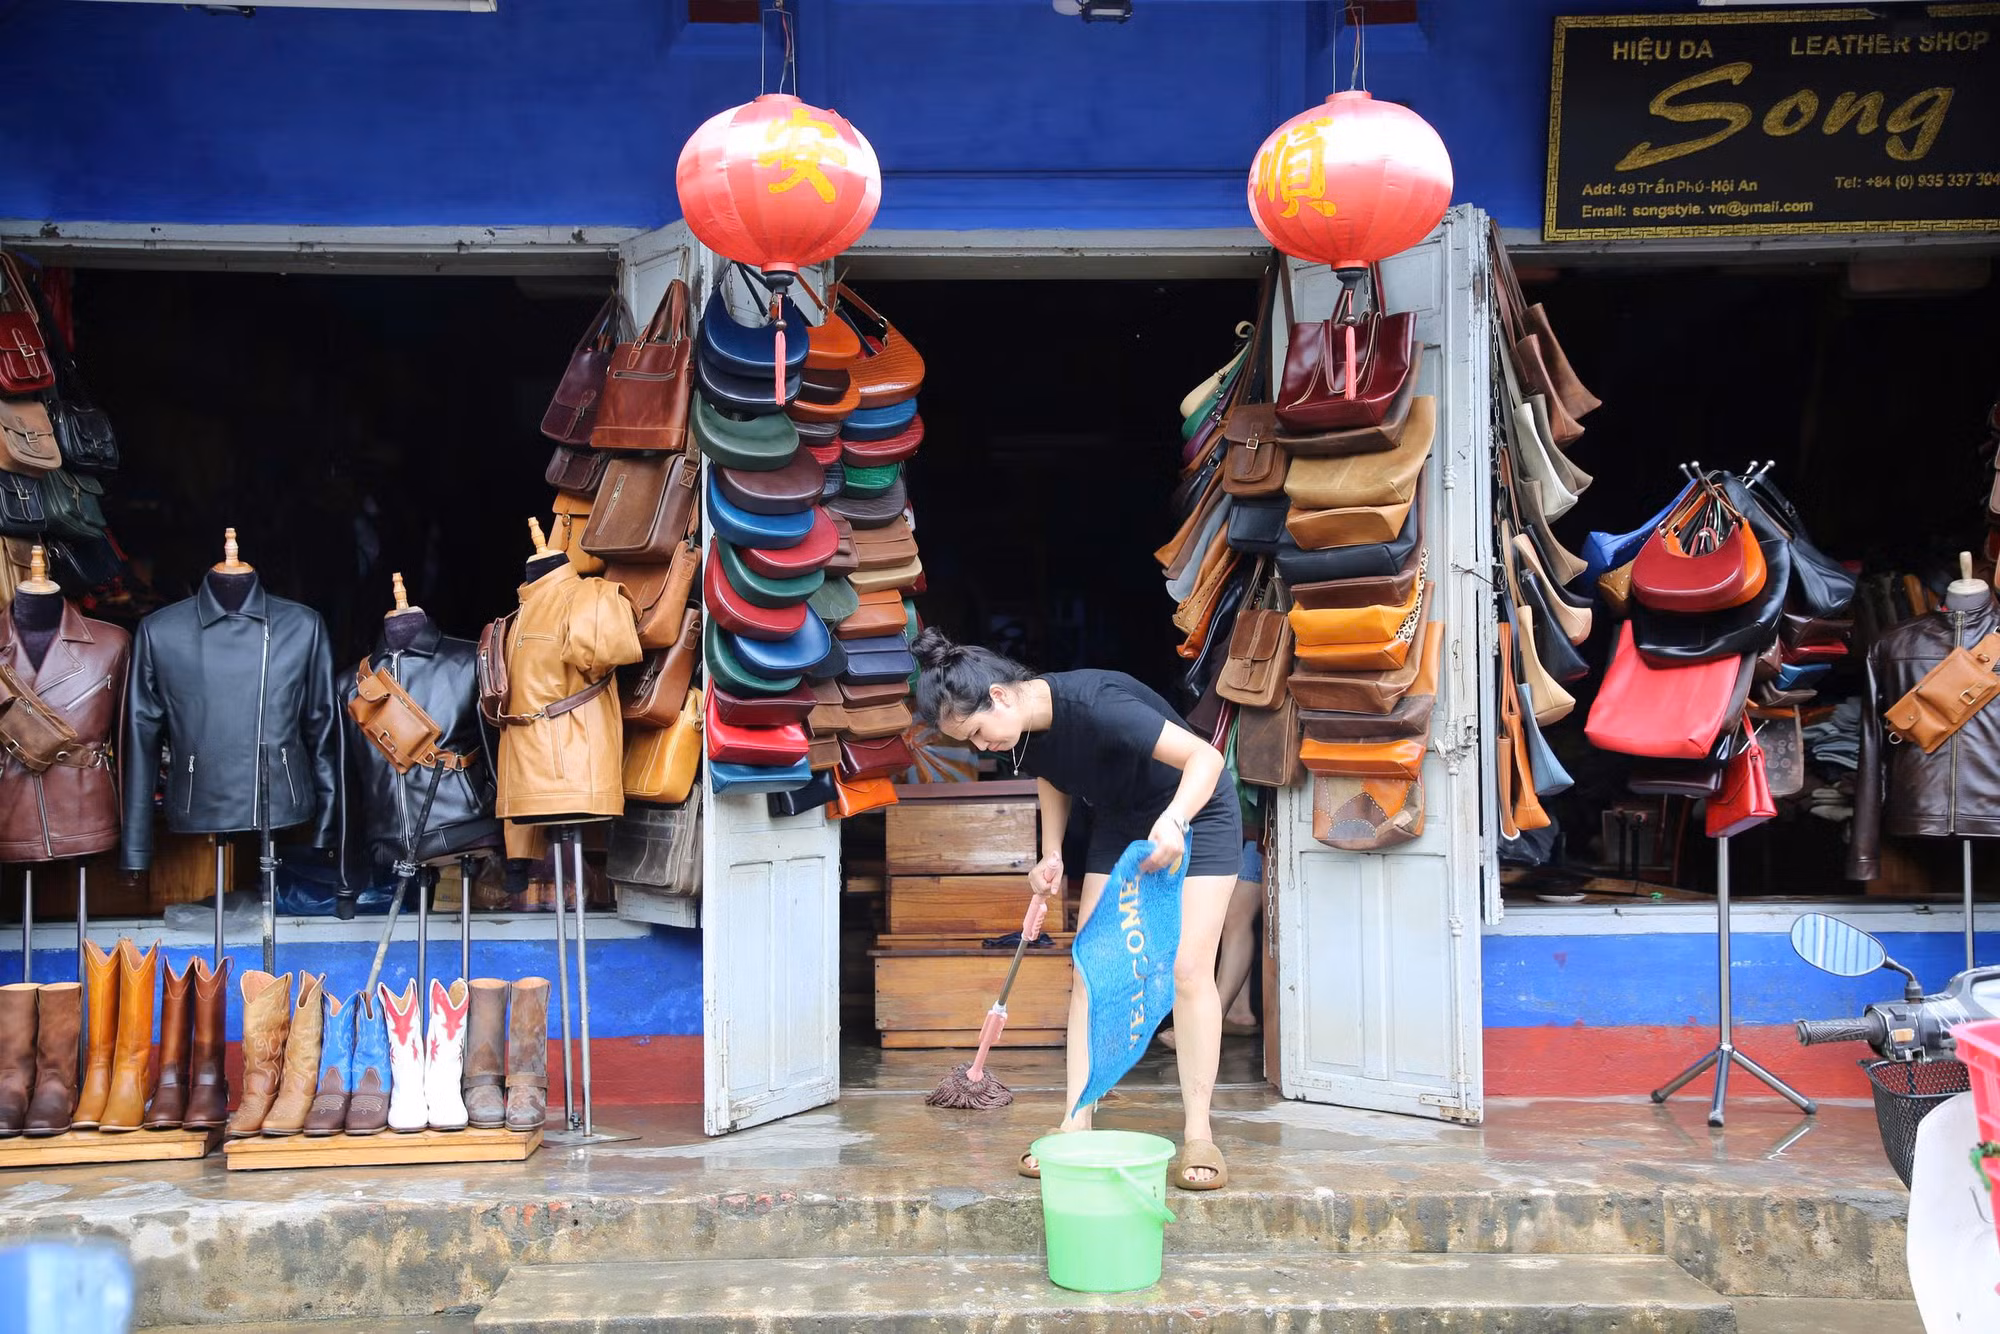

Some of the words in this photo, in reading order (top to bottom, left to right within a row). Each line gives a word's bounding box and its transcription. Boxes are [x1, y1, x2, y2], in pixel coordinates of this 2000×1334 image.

[1613, 37, 1671, 65] HIỆU
[1680, 40, 1713, 59] DA
[1791, 34, 1910, 55] LEATHER
[1919, 31, 1990, 52] SHOP
[1614, 61, 1955, 171] Song
[1256, 116, 1337, 218] 順
[1582, 183, 1616, 196] Add:
[1618, 182, 1636, 194] 49
[1738, 180, 1758, 191] An
[1835, 176, 1862, 189] Tel:
[1865, 175, 1892, 188] +84
[1895, 174, 1914, 189] (0)
[1918, 173, 1945, 187] 935
[1947, 173, 1974, 186] 337
[1582, 205, 1626, 218] Email:
